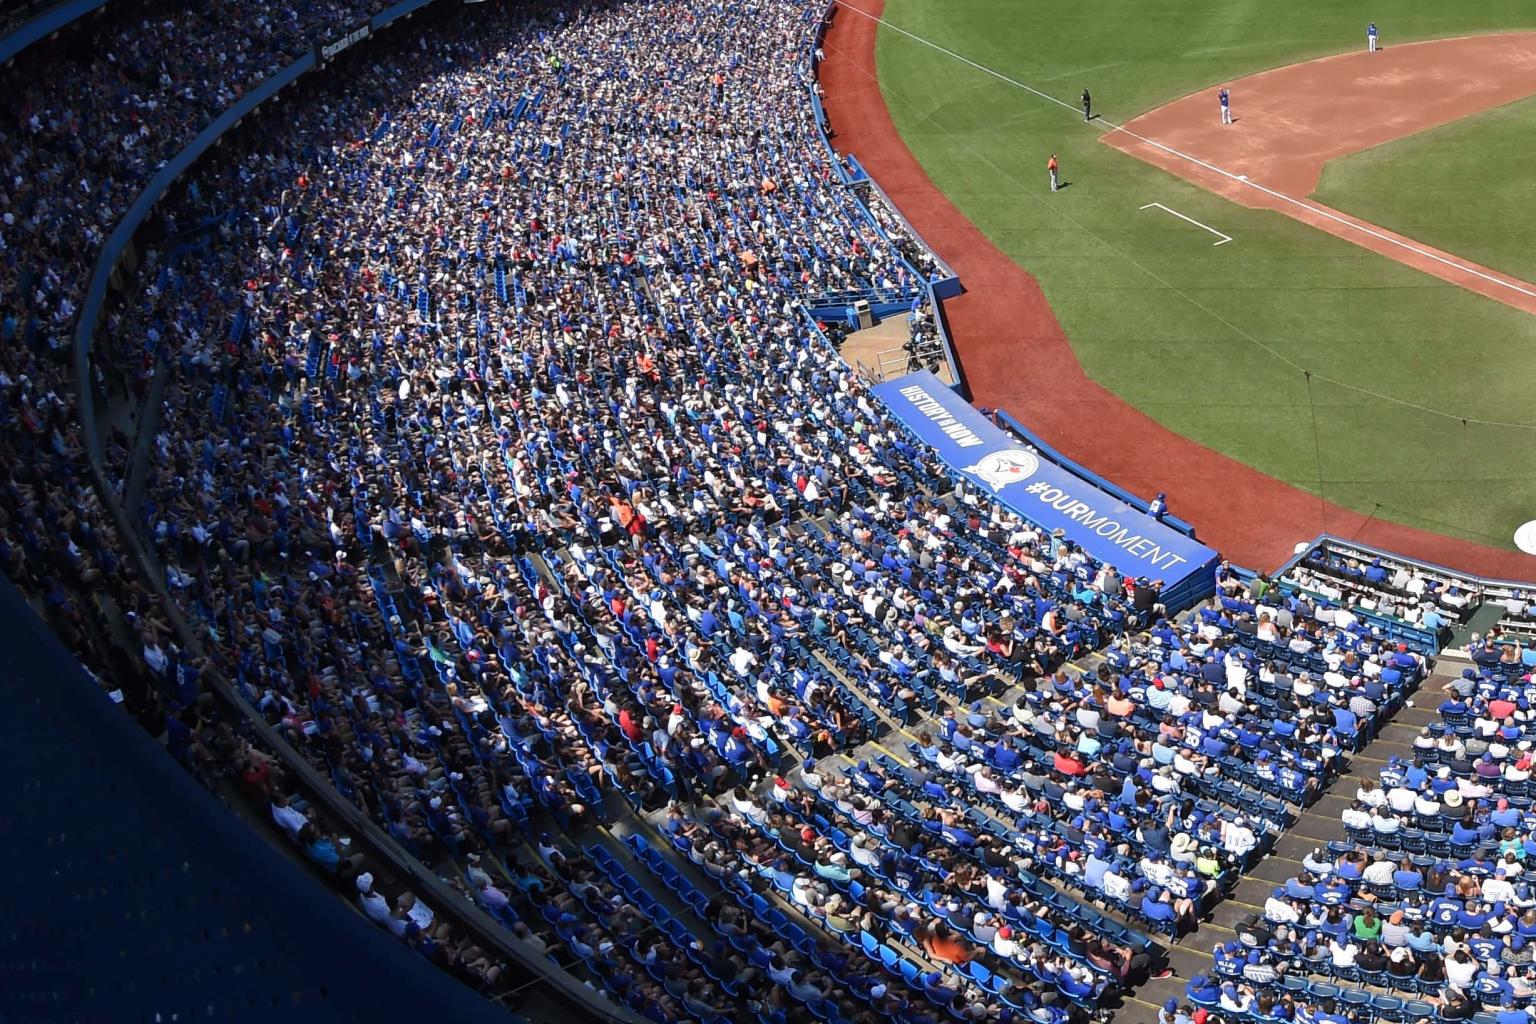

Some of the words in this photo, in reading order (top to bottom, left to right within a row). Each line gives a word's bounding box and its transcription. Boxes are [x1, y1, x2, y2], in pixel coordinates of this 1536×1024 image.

[899, 385, 946, 422] HISTORY
[944, 419, 985, 448] NOW
[1024, 481, 1188, 572] #OURMOMENT
